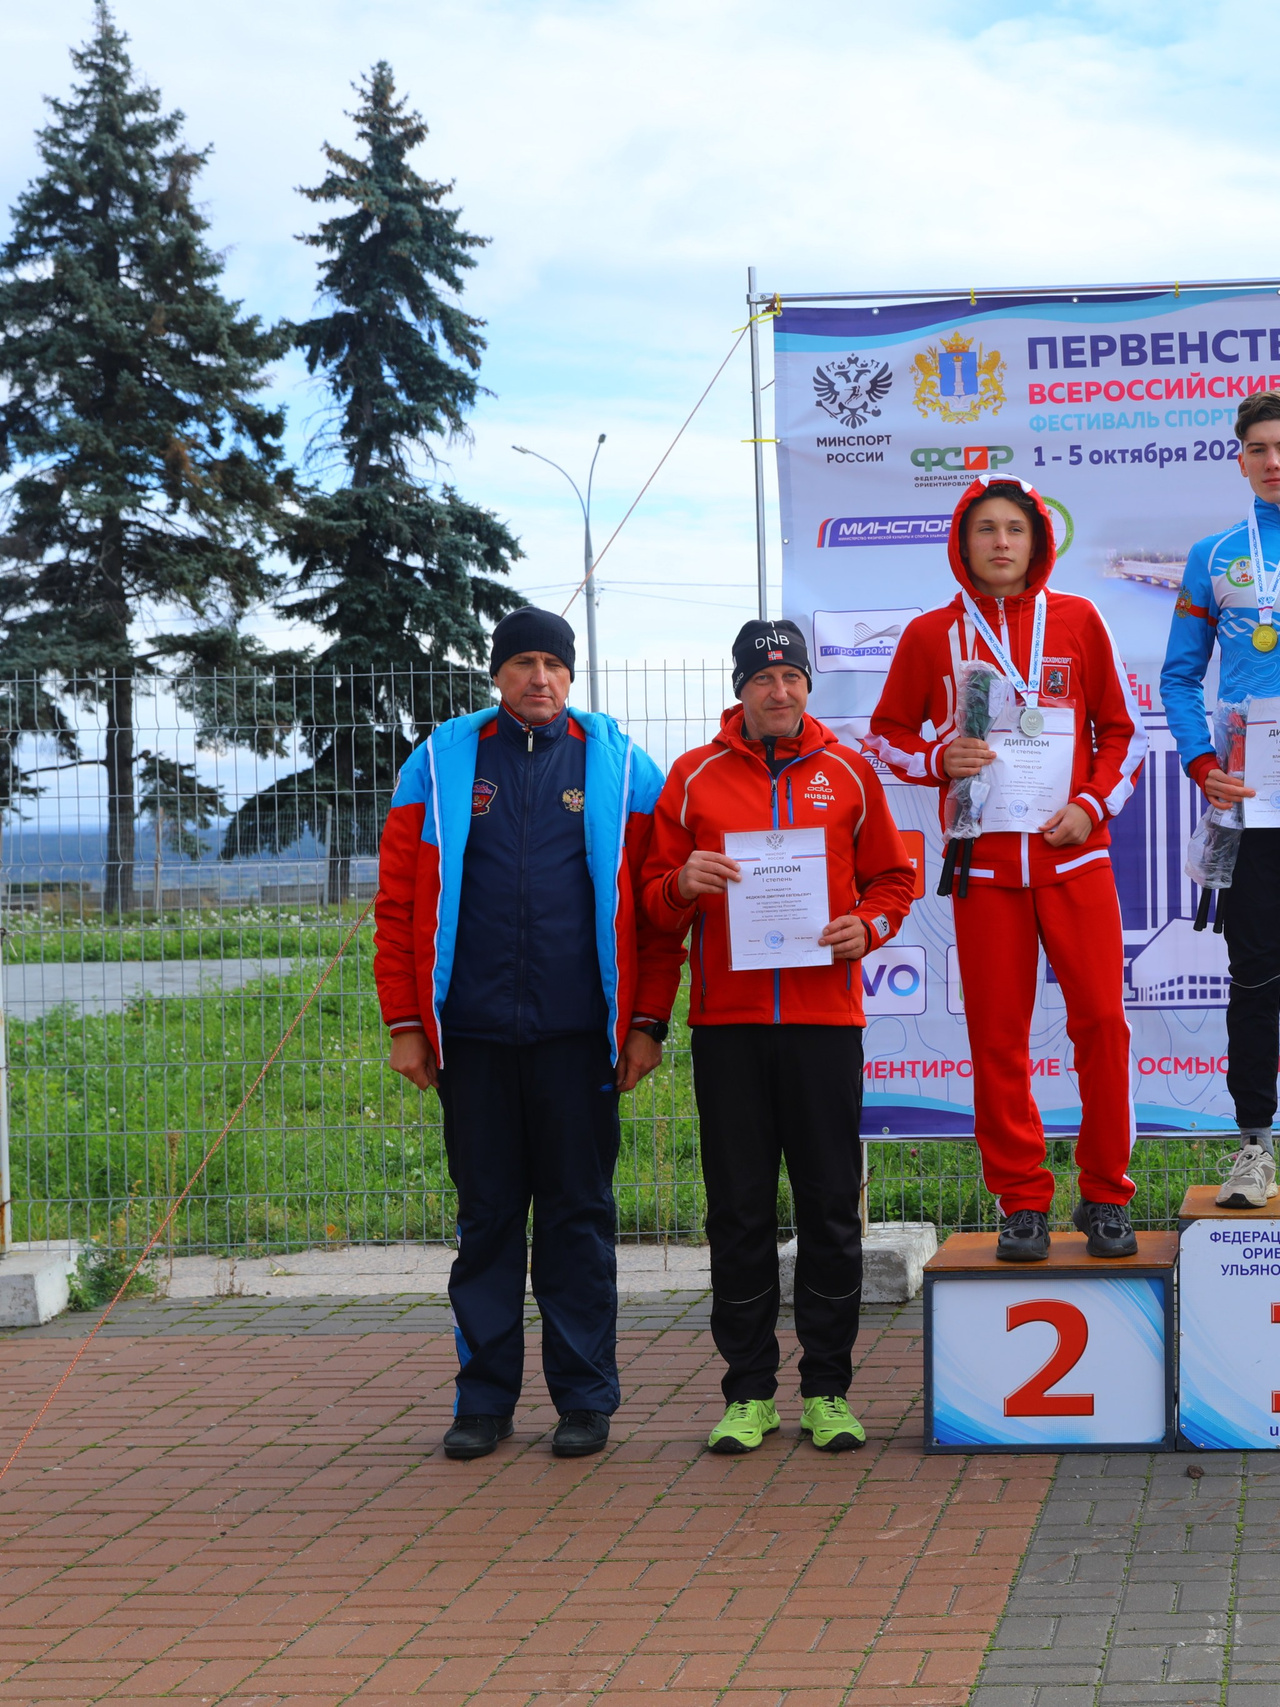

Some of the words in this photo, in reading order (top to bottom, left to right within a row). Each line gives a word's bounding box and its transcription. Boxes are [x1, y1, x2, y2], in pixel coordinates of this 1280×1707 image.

[1029, 411, 1160, 433] ФЕСТИВАЛЬ
[816, 434, 892, 447] МИНСПОРТ
[827, 451, 884, 464] РОССИИ
[1033, 446, 1046, 466] 1
[1069, 445, 1082, 465] 5
[1089, 443, 1187, 468] октября
[1193, 440, 1240, 461] 202
[914, 474, 957, 482] ФЕДЕРАЦИЯ
[914, 481, 973, 489] ОРИЕНТИРОВАН
[839, 519, 953, 536] МИНСПОР
[755, 630, 790, 650] DNB
[973, 612, 995, 645] МИНИСТЕРСТВО
[993, 641, 1005, 661] СПОРТА
[1003, 659, 1016, 677] РОССИИ
[1003, 738, 1050, 748] ДИПЛОМ
[804, 793, 836, 801] RUSSIA
[753, 864, 801, 876] ДИПЛОМ
[1003, 1298, 1095, 1417] 2
